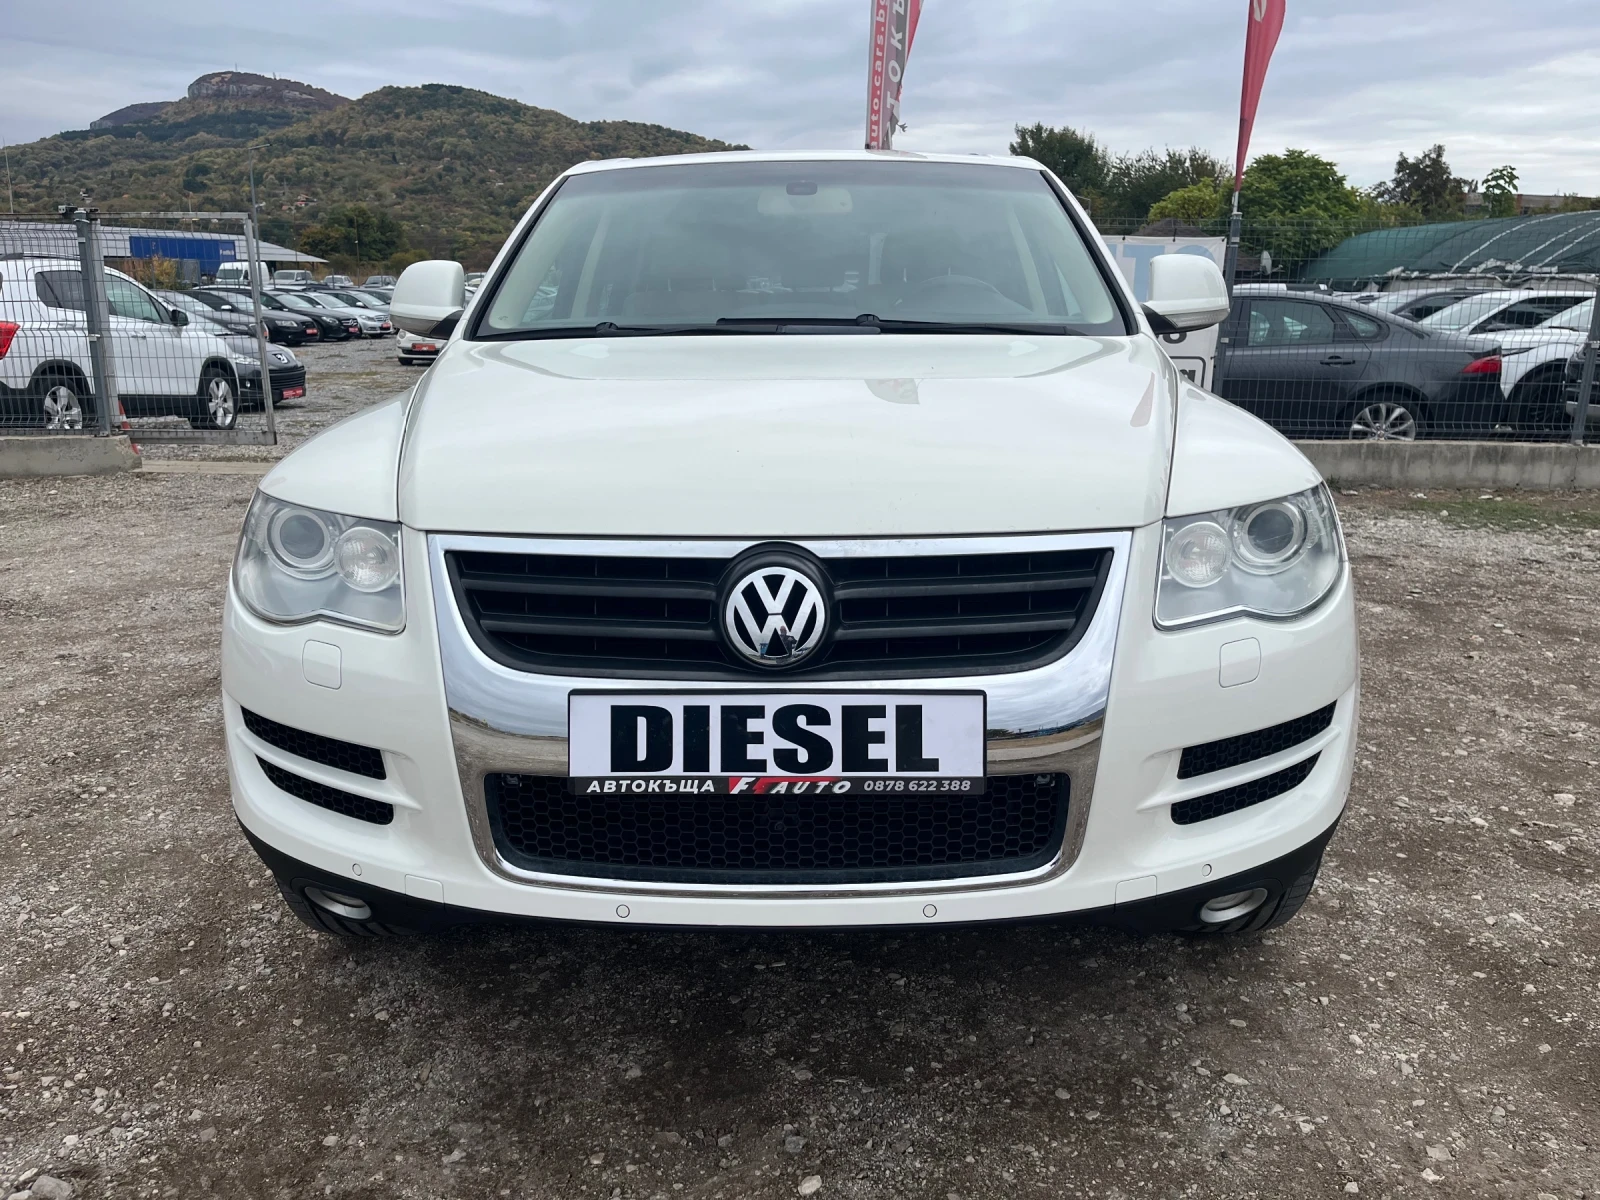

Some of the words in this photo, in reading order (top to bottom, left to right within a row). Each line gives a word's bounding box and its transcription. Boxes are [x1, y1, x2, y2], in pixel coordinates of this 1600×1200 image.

[610, 704, 940, 774] DIESEL
[586, 779, 715, 794] АВТОКЪЩА
[770, 780, 852, 794] AUTO
[863, 780, 905, 792] 0878
[907, 780, 938, 792] 622
[939, 780, 971, 792] 388
